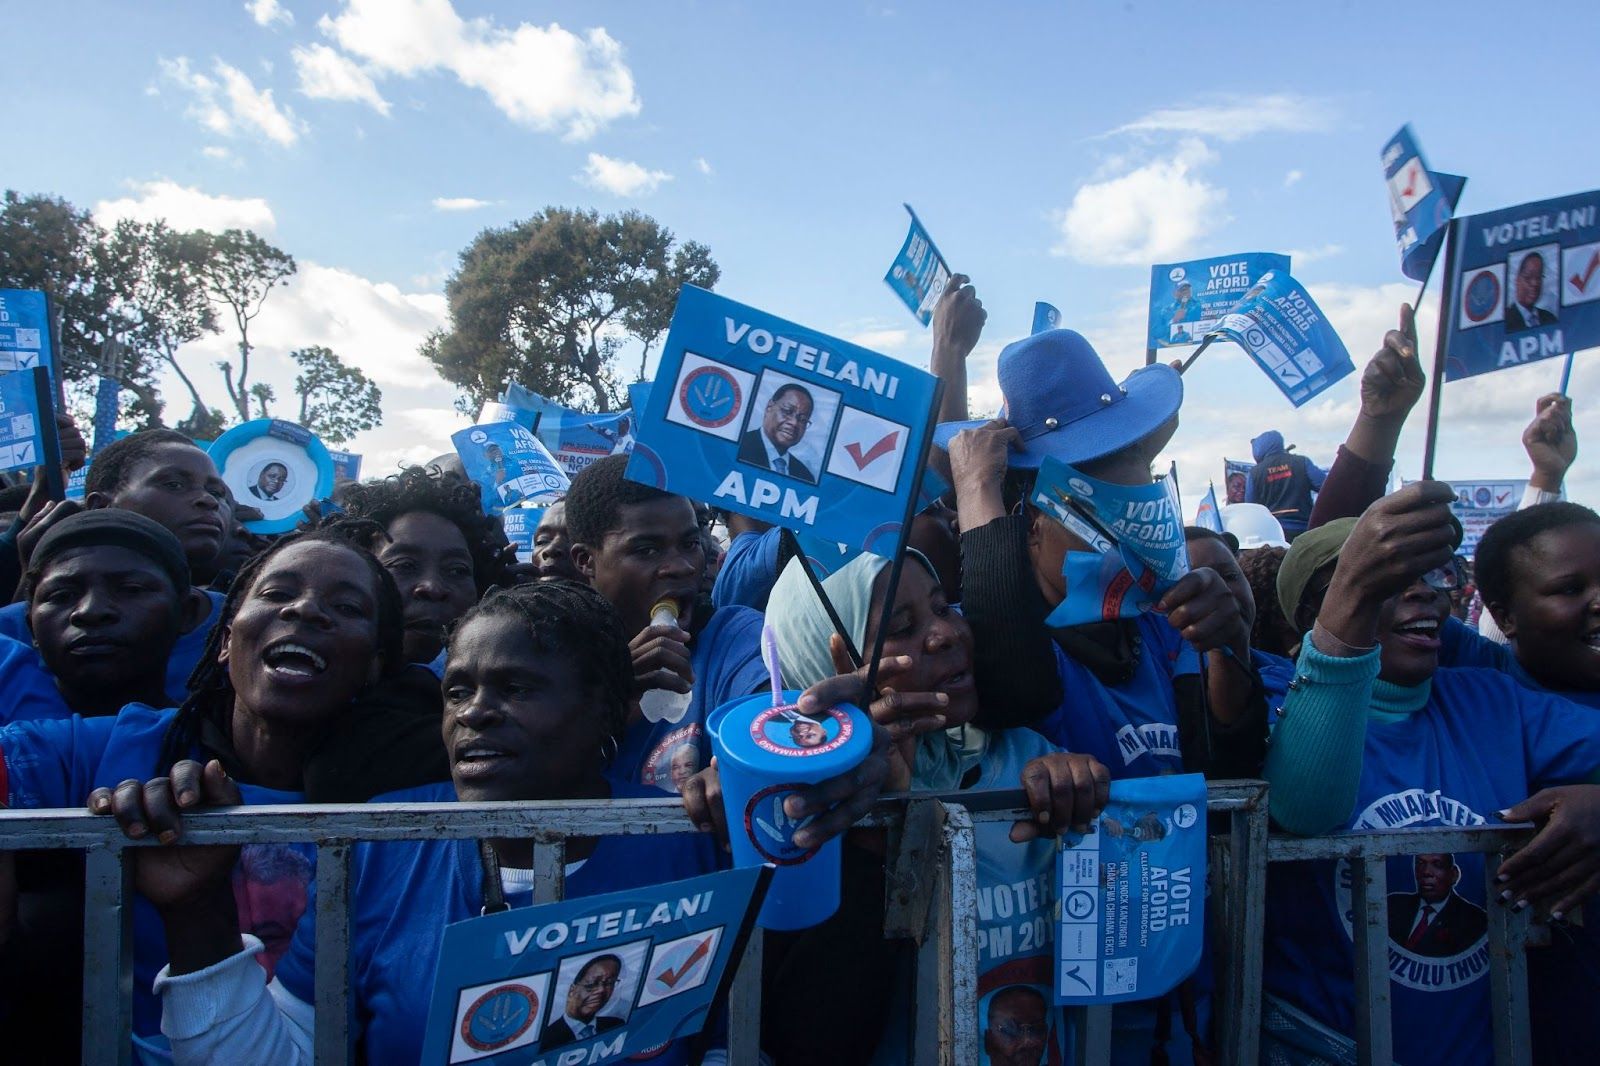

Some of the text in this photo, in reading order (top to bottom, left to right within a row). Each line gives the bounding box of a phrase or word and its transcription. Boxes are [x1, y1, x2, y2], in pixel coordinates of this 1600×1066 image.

[1482, 205, 1596, 247] VOTELANI
[1207, 276, 1250, 290] AFORD
[1210, 262, 1247, 278] VOTE
[1274, 297, 1310, 331] AFORD
[1288, 290, 1318, 324] VOTE
[724, 316, 900, 400] VOTELANI
[1498, 330, 1564, 366] APM
[713, 470, 820, 525] APM
[1126, 497, 1172, 522] VOTE
[1112, 518, 1174, 540] AFORD
[1106, 862, 1116, 902] CHAKUFWA
[1119, 861, 1128, 878] HON.
[1140, 852, 1148, 886] ALLIANCE
[976, 878, 1038, 920] VOTE
[1119, 880, 1128, 904] ENOCK
[1150, 866, 1168, 932] AFORD
[1170, 866, 1192, 928] VOTE
[504, 890, 714, 956] VOTELANI
[1106, 903, 1116, 935] CHIHANA
[1140, 904, 1148, 948] DEMOCRACY
[977, 925, 1012, 961] PM
